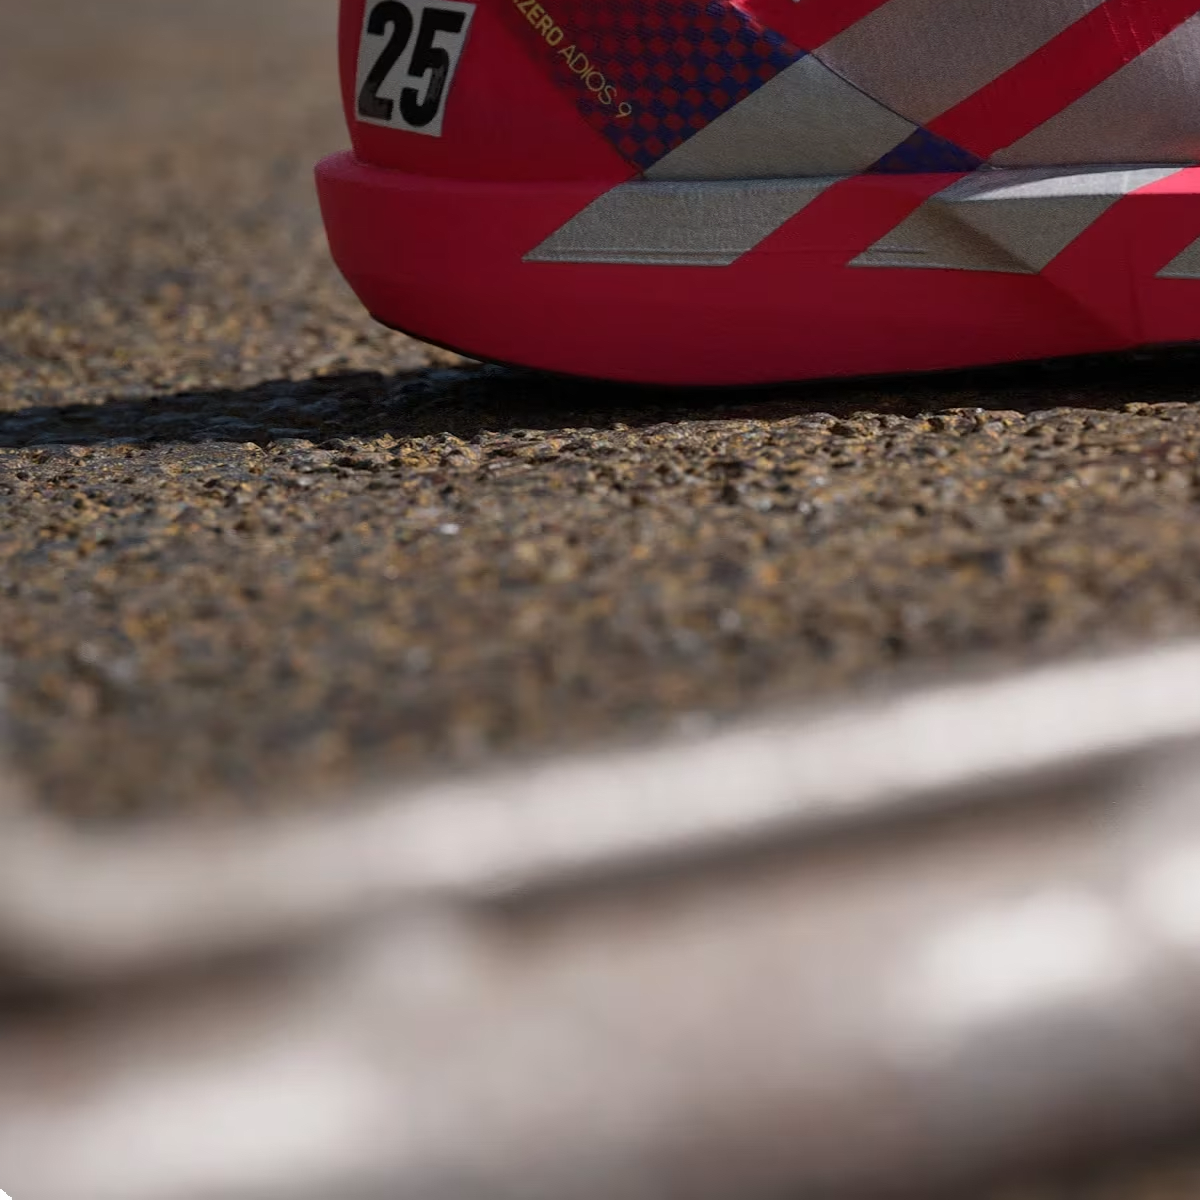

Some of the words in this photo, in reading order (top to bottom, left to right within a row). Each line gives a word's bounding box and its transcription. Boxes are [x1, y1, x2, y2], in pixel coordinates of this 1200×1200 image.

[358, 0, 467, 127] 25
[557, 44, 618, 105] ADIOS
[615, 101, 633, 118] 9
